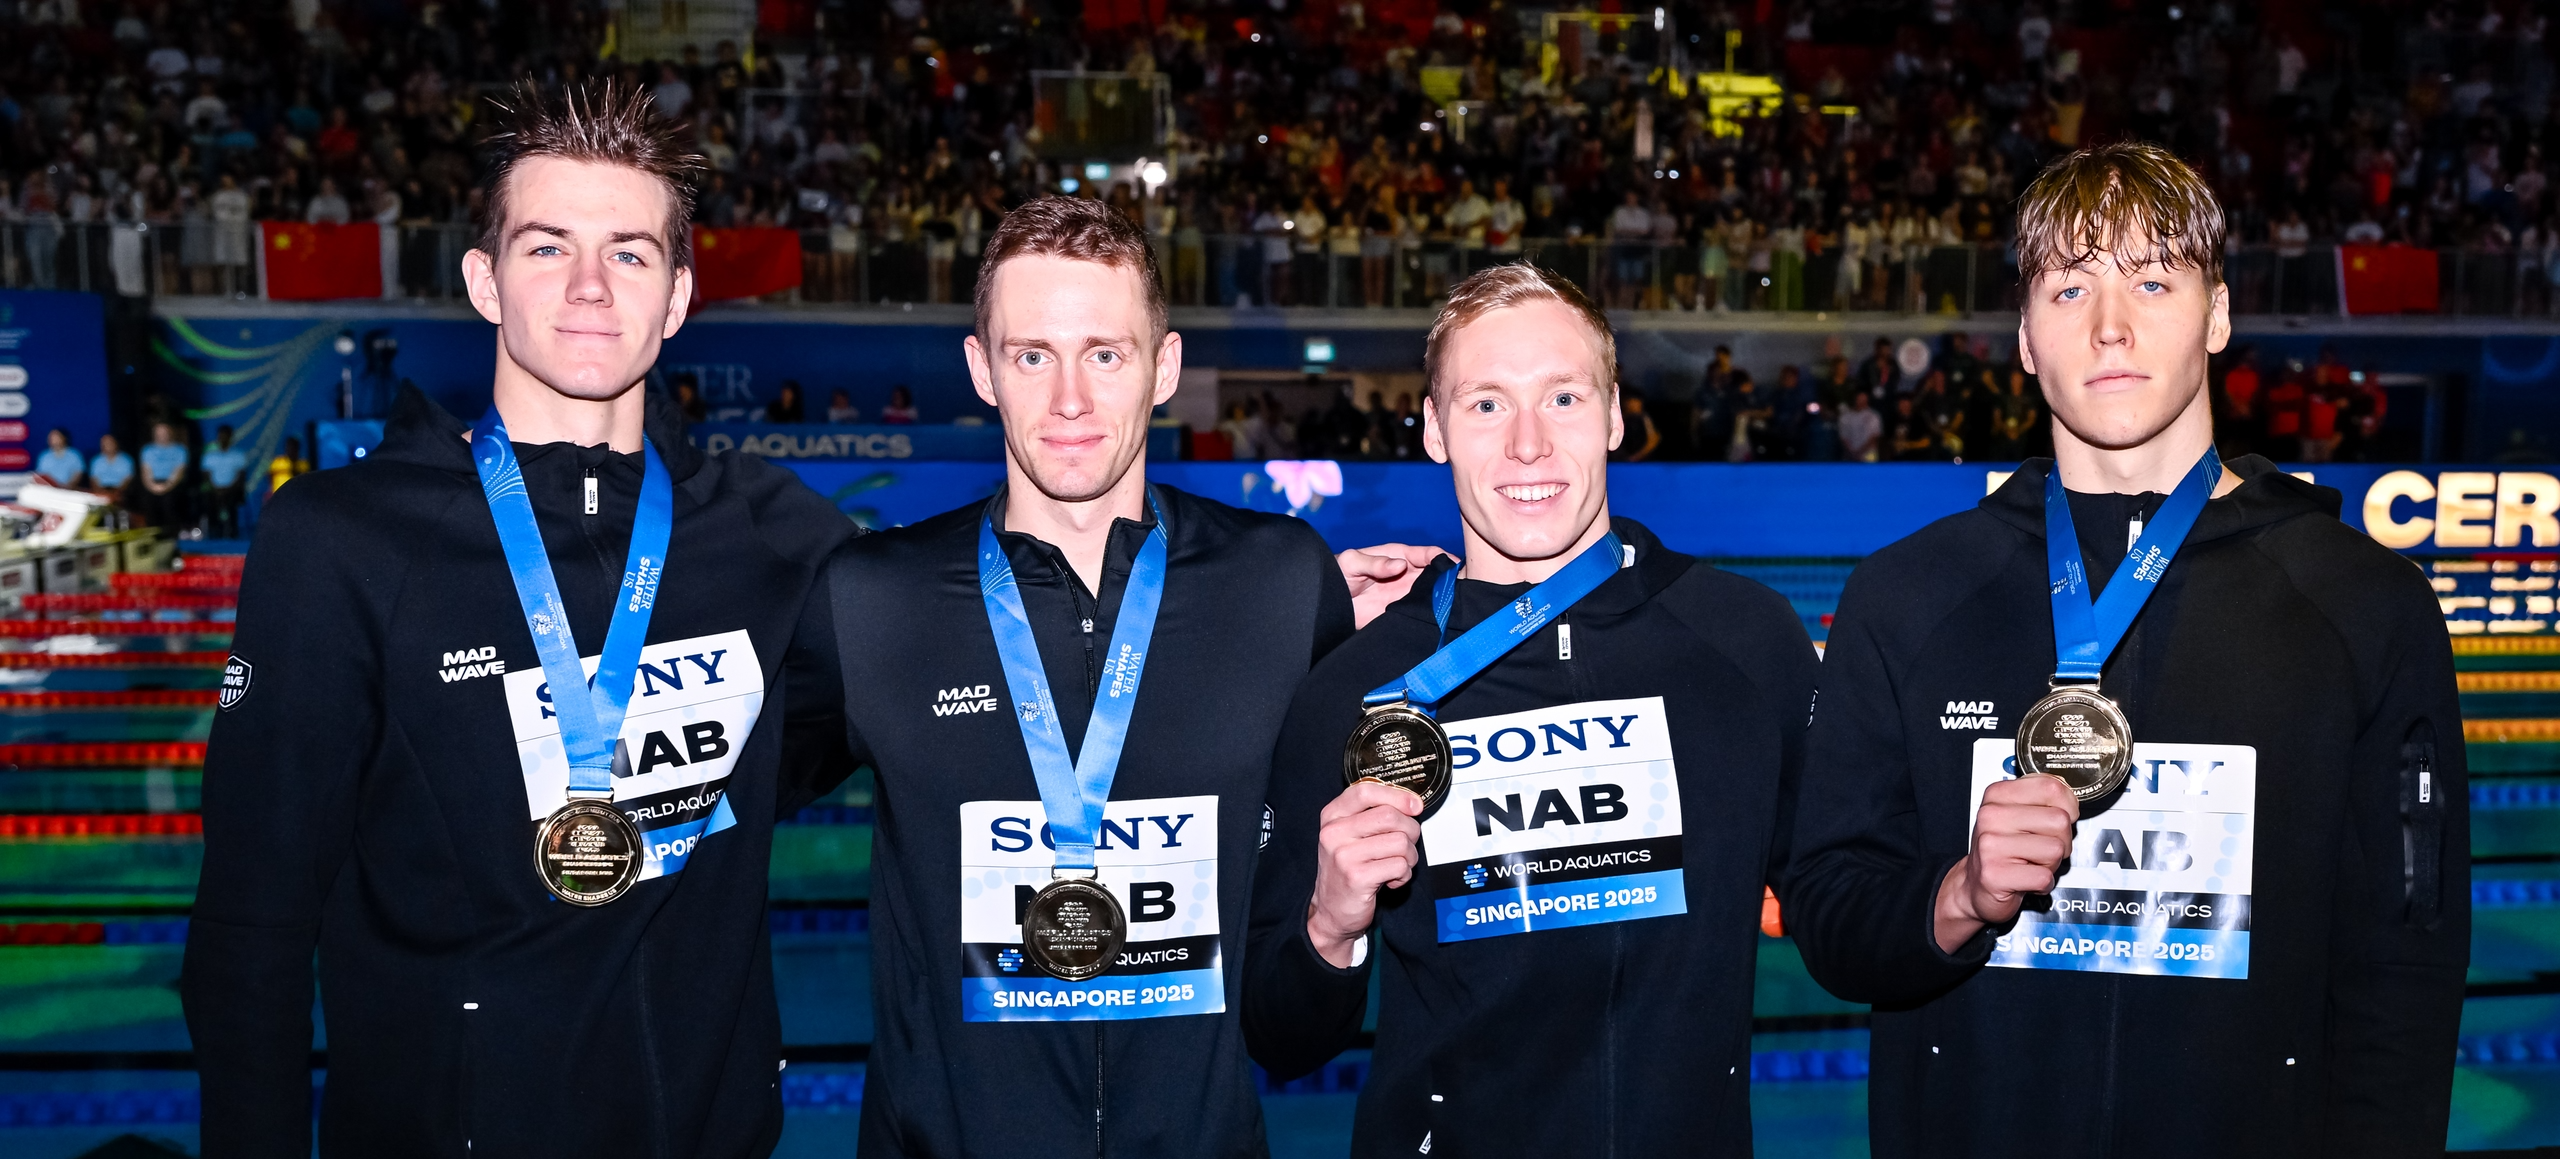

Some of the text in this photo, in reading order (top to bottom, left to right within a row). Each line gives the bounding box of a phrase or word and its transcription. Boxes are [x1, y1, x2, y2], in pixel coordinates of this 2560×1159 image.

[739, 433, 913, 458] AQUATICS
[2362, 470, 2560, 549] CER
[2130, 548, 2144, 562] US
[2133, 544, 2161, 582] SHAPES
[623, 571, 636, 588] US
[2145, 556, 2170, 584] WATER
[628, 556, 651, 613] SHAPES
[640, 567, 660, 610] WATER
[1508, 603, 1551, 635] WORLD AQUATICS
[443, 646, 496, 667] MAD
[1103, 658, 1116, 675] US
[223, 676, 245, 686] AVE
[438, 660, 506, 683] WAVE
[1110, 643, 1132, 699] SHAPES
[1122, 652, 1142, 694] WATER
[536, 649, 728, 719] SNY
[938, 684, 991, 702] MAD
[932, 698, 997, 717] WAVE
[1945, 701, 1994, 714] MAD
[1939, 716, 1999, 730] WAVE
[1448, 714, 1639, 769] SONY
[624, 803, 675, 823] ORLD
[1472, 783, 1629, 837] NAB
[990, 813, 1194, 852] SNY
[2094, 828, 2193, 872] AB
[1494, 849, 1652, 879] WORLD AQUATICS
[1465, 886, 1658, 926] SINGAPORE 2025
[2041, 899, 2212, 918] ORLD AQUATICS
[1115, 948, 1188, 966] QUATICS
[2153, 943, 2215, 962] 2025
[993, 984, 1195, 1008] SINGAPORE 2025
